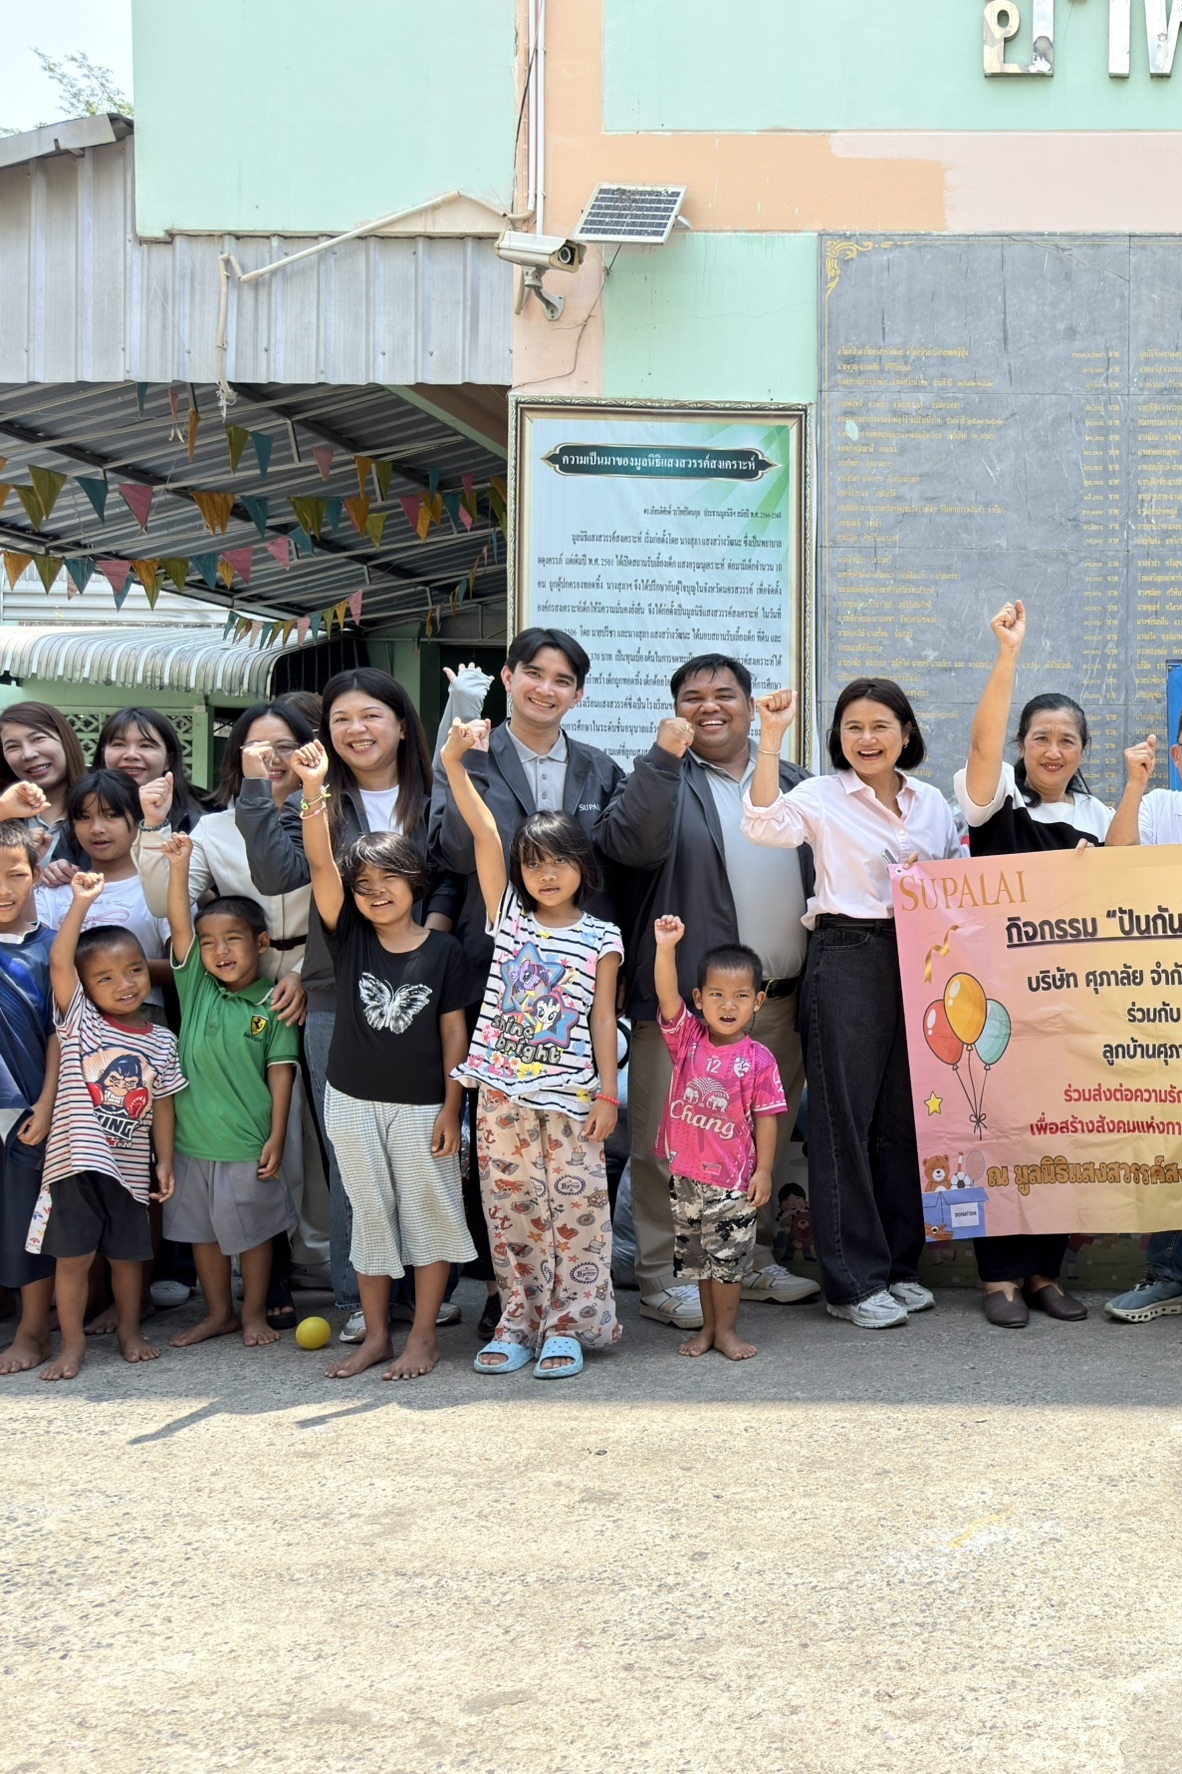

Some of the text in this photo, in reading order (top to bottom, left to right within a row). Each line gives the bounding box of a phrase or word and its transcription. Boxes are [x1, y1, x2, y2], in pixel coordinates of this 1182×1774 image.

[562, 451, 757, 472] ความเป็นมาของมูลนิธิแสงสวรรค์สงเคราะห์
[899, 869, 1028, 912] SUPALAI
[1005, 915, 1098, 944] กิจกรรม
[1027, 966, 1079, 993] บริษัท
[1085, 963, 1145, 994] ศุภาลัย
[1126, 1001, 1182, 1024] ร่วมกับ
[494, 1033, 561, 1065] bright
[705, 1058, 722, 1074] 12
[669, 1099, 736, 1140] Chang
[986, 1165, 1009, 1189] ณ
